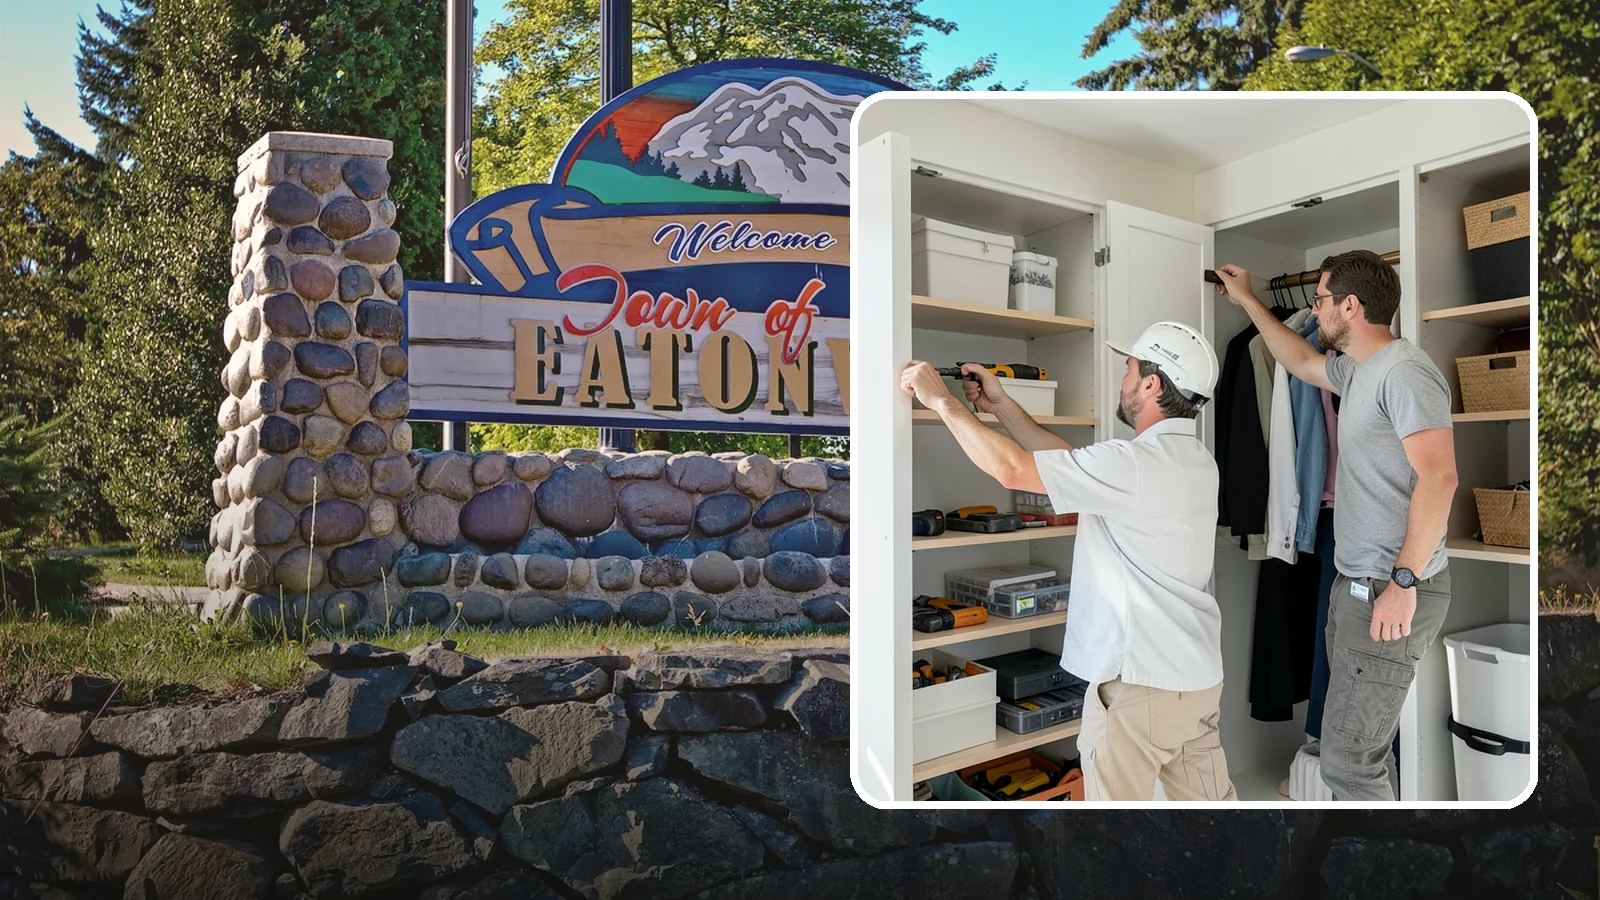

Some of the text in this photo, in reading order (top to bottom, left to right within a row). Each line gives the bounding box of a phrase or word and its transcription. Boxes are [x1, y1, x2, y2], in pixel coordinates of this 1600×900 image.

[653, 221, 837, 263] Welcome
[557, 263, 825, 365] Town of
